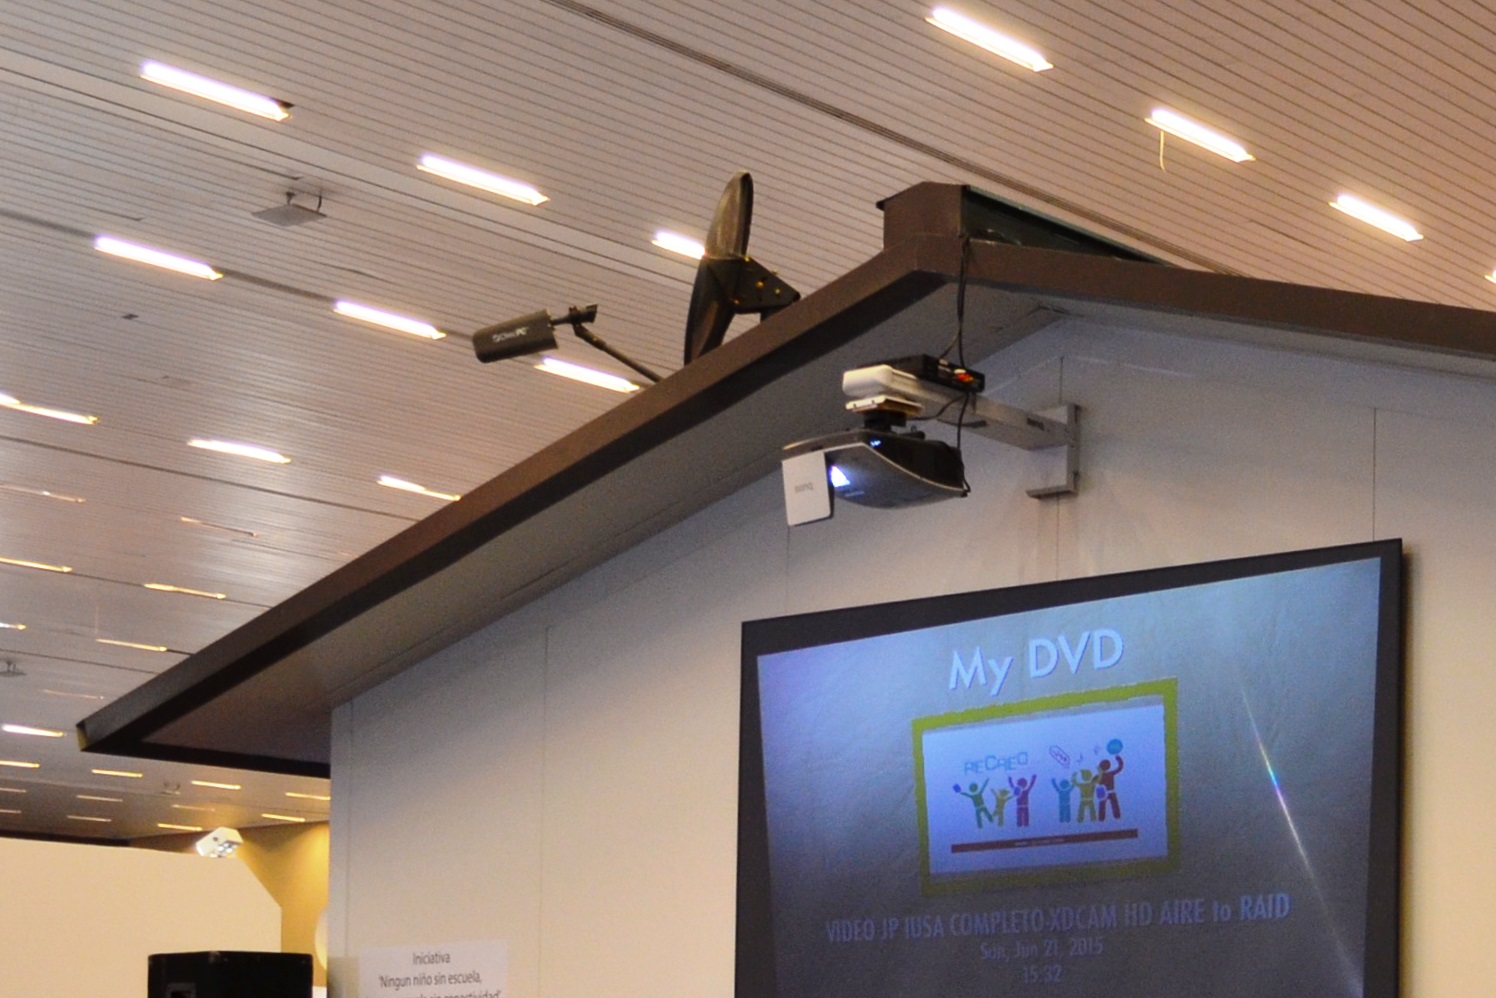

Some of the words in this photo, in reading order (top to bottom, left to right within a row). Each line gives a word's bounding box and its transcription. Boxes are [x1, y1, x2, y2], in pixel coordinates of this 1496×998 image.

[948, 646, 1014, 696] My
[1028, 628, 1125, 679] DVD
[964, 752, 1029, 775] RECREO
[826, 918, 876, 943] VIDEO
[1124, 901, 1153, 927] HD
[1160, 898, 1205, 925] AIRE
[1240, 892, 1292, 921] RAID
[413, 952, 450, 965] Iniciativa
[413, 973, 432, 986] niño
[434, 972, 447, 984] sin
